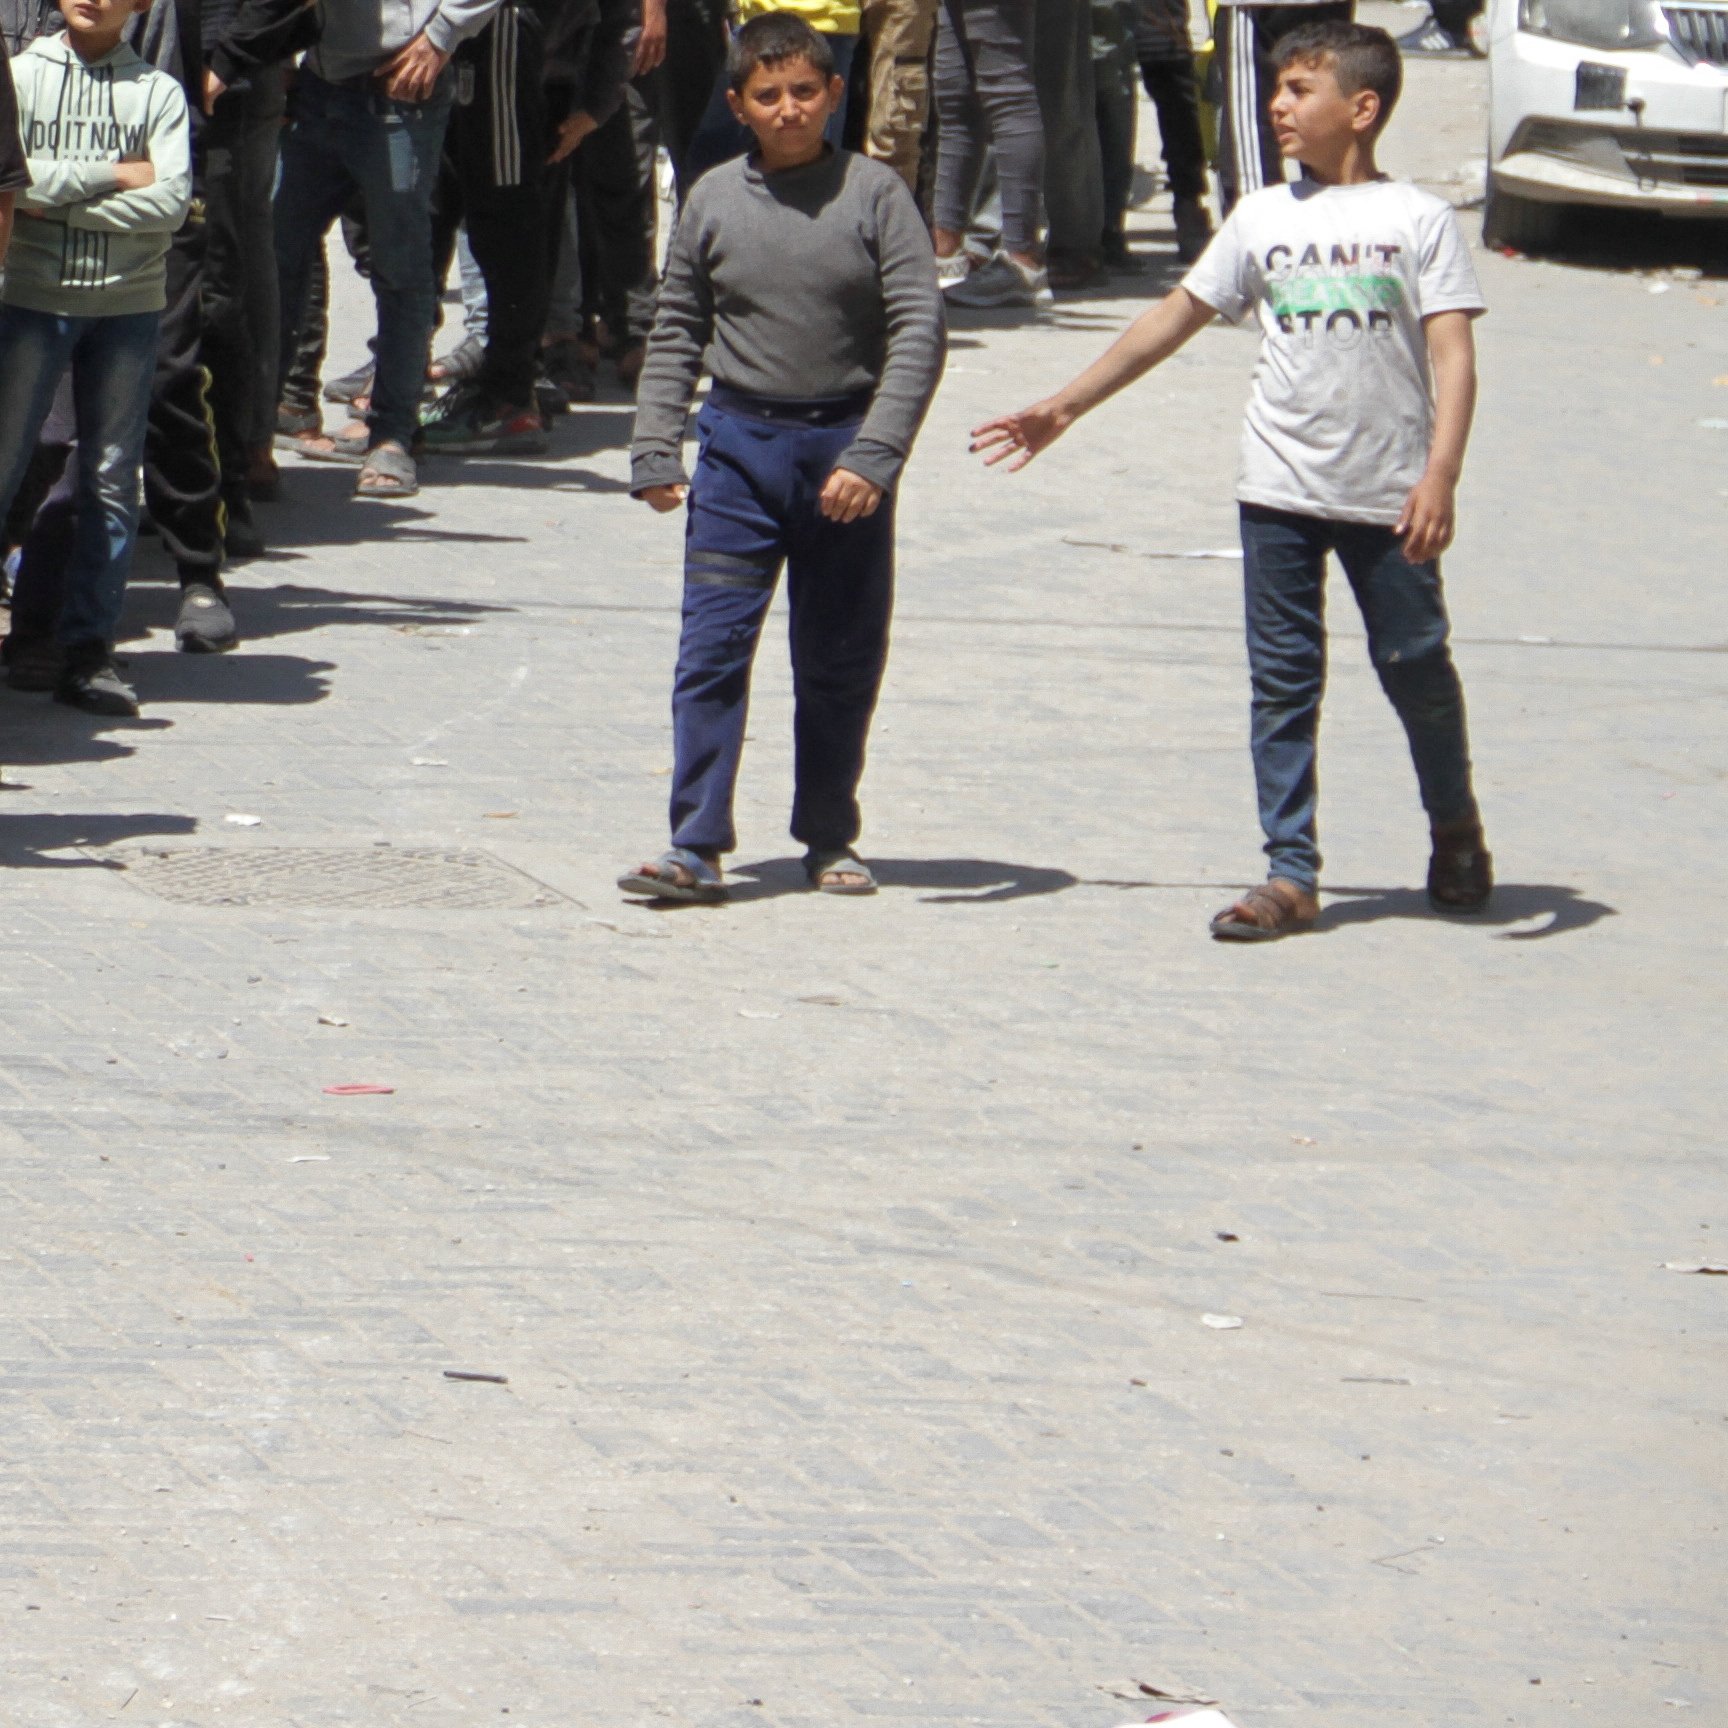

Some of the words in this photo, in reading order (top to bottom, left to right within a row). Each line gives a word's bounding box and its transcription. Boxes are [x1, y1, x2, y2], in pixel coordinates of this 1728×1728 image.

[34, 120, 60, 151] DO
[65, 121, 86, 151] IT
[91, 122, 146, 156] NOW
[1265, 243, 1402, 276] CAN'T
[1275, 308, 1394, 346] STOP
